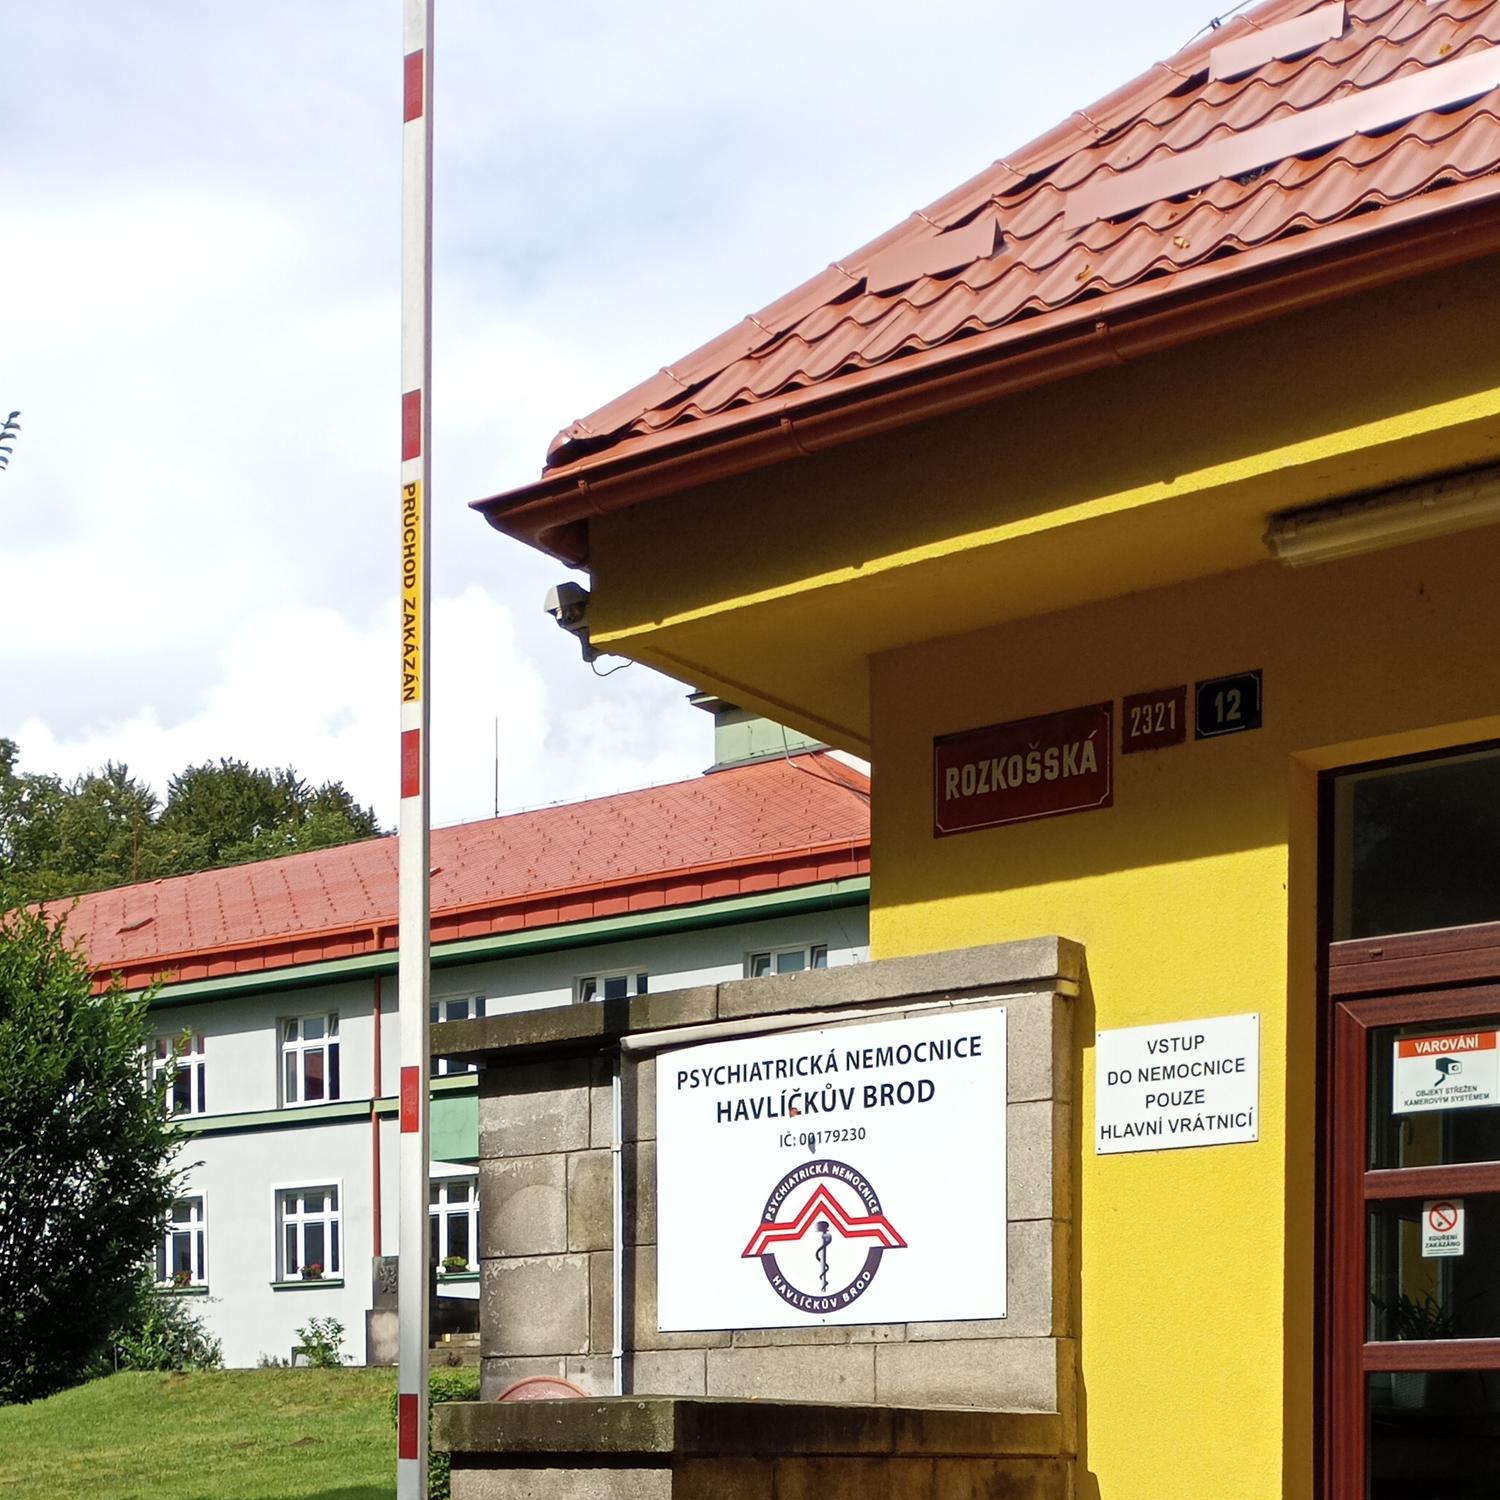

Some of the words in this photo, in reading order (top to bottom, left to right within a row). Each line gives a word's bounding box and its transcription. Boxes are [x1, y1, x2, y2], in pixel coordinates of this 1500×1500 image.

[403, 482, 420, 590] PRŮCHOD
[403, 597, 420, 702] ZAKÁZÁN
[1130, 700, 1176, 737] 2321
[1214, 688, 1242, 723] 12
[945, 729, 1098, 800] ROZKOŠSKÁ
[677, 1049, 839, 1090] PSYCHIATRICKÁ
[845, 1035, 982, 1071] NEMOCNICE
[1147, 1035, 1205, 1055] VSTUP
[1415, 1034, 1479, 1054] VAROVÁNÍ
[1107, 1070, 1132, 1086] DO
[1138, 1057, 1246, 1083] NEMOCNICE
[716, 1083, 855, 1123] HAVLÍČKŮV
[863, 1078, 936, 1109] BROD
[1145, 1089, 1206, 1109] POUZE
[779, 1130, 797, 1148] IČ:
[799, 1127, 866, 1146] 00179230
[1100, 1116, 1163, 1140] HLAVNÍ
[1168, 1106, 1254, 1134] VRÁTNICÍ
[765, 1162, 829, 1222] PSYCHIATRICKÁ
[831, 1164, 880, 1214] NEMOCNICE
[772, 1275, 838, 1311] HAVLÍČKŮV
[842, 1270, 871, 1303] BROD
